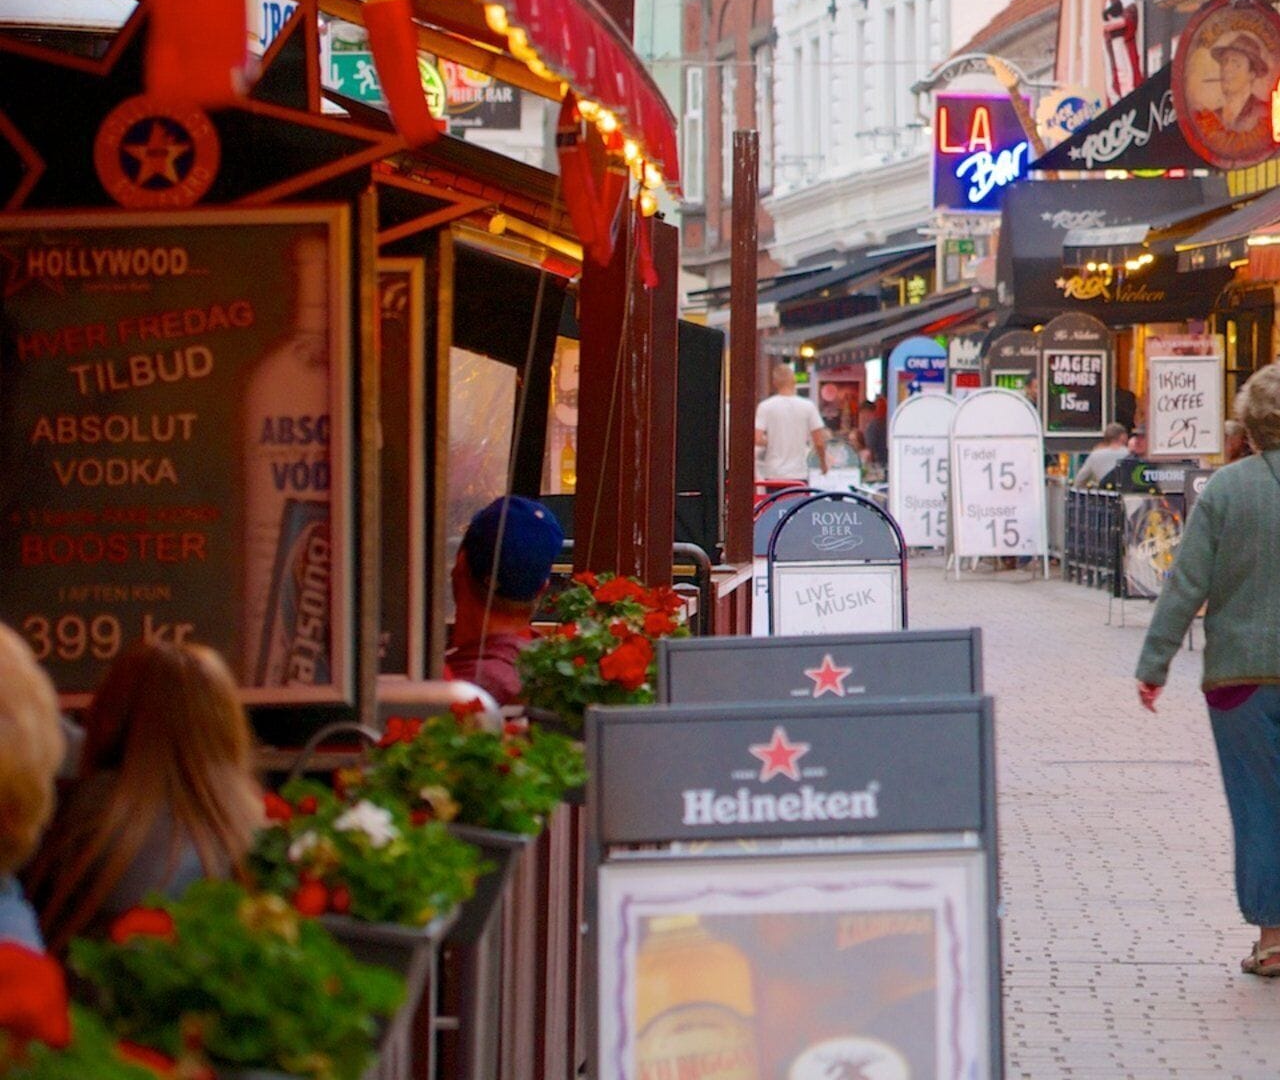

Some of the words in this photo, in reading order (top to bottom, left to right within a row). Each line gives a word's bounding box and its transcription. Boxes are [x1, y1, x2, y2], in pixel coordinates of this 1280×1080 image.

[939, 106, 991, 154] LA
[956, 142, 1029, 204] Bar
[26, 247, 190, 277] HOLLYWOOD
[18, 322, 110, 361] HVER
[117, 300, 257, 344] FREDAG
[68, 345, 215, 397] TILBUD
[1158, 371, 1197, 391] IRISH
[1157, 392, 1204, 412] COFFEE
[29, 413, 199, 446] ABSOLUT
[52, 456, 179, 488] VODKA
[811, 512, 862, 526] ROYAL
[967, 503, 1017, 519] Sjusser
[821, 525, 853, 536] BEER
[20, 531, 208, 566] BOOSTER
[795, 582, 835, 606] LIVE
[815, 588, 876, 617] MUSIK
[682, 786, 879, 825] Heineken
